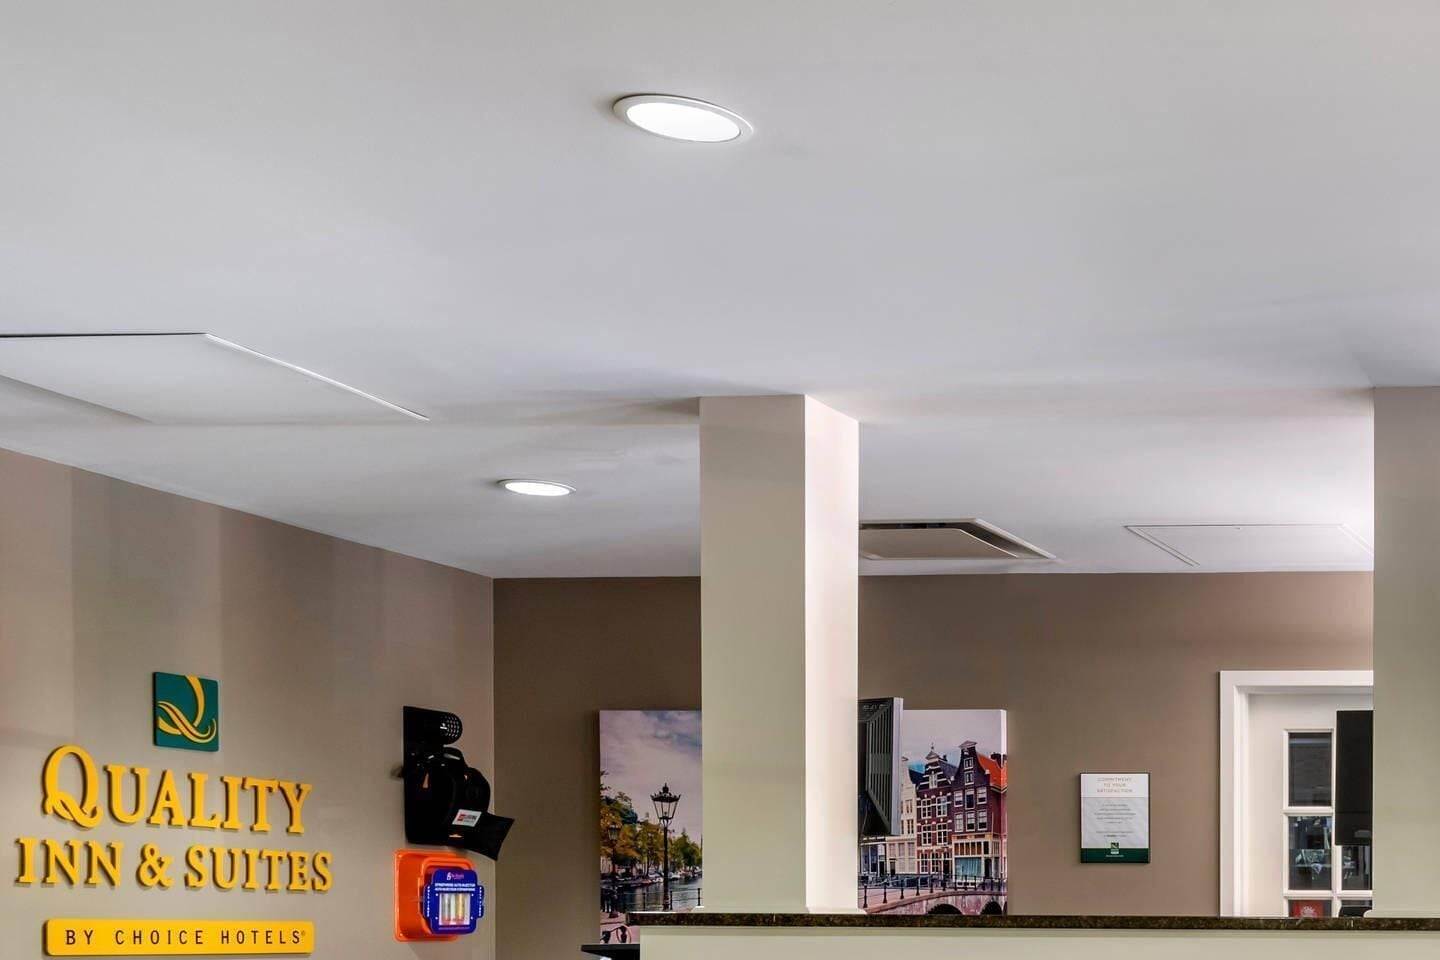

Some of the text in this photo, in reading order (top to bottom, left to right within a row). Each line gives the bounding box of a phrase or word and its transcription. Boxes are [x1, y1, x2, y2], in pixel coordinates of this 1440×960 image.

[43, 744, 313, 834] QUALITY
[16, 837, 333, 892] INN & SUITES
[65, 929, 94, 945] BY
[115, 929, 204, 945] CHOICE
